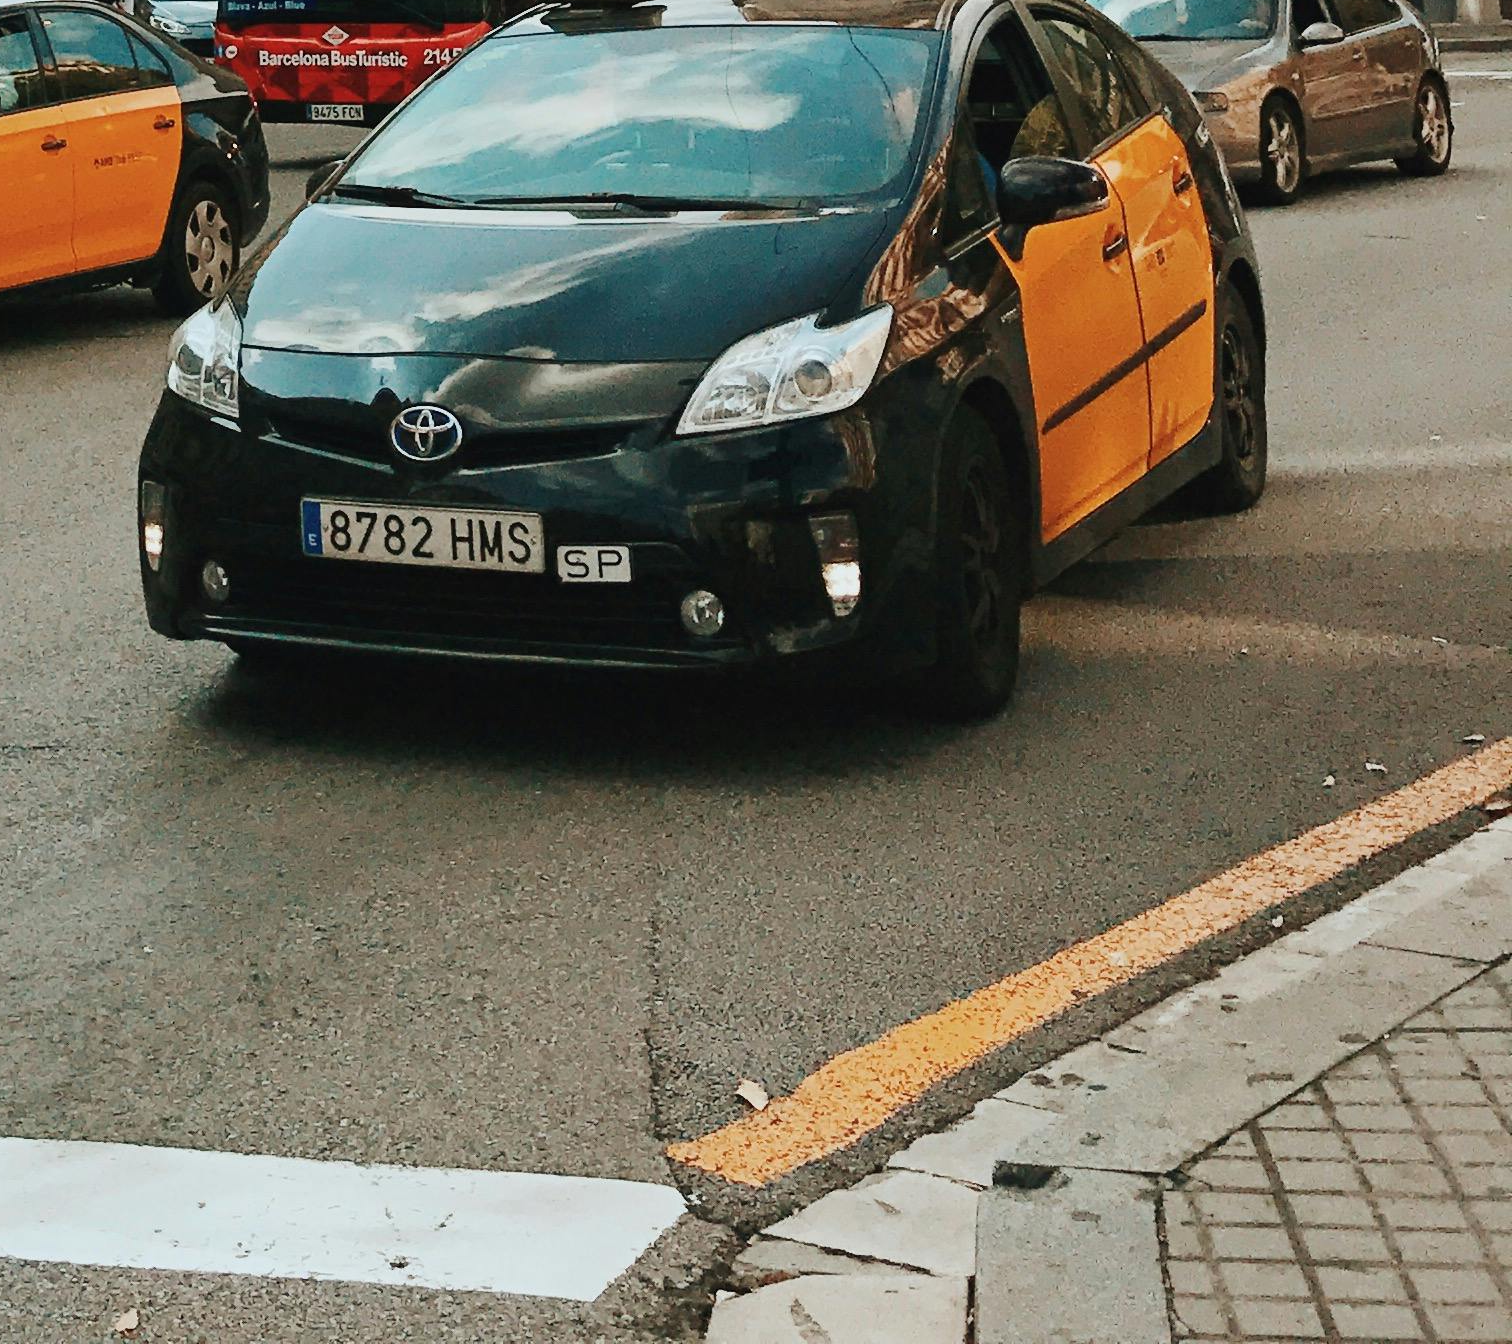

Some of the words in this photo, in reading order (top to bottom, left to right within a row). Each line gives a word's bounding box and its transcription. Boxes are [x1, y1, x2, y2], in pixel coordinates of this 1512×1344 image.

[284, 0, 306, 10] Blue
[258, 50, 329, 67] Barcelona
[309, 533, 318, 547] E
[329, 509, 435, 560] 8782
[449, 517, 532, 565] HMS
[563, 548, 623, 579] SP
